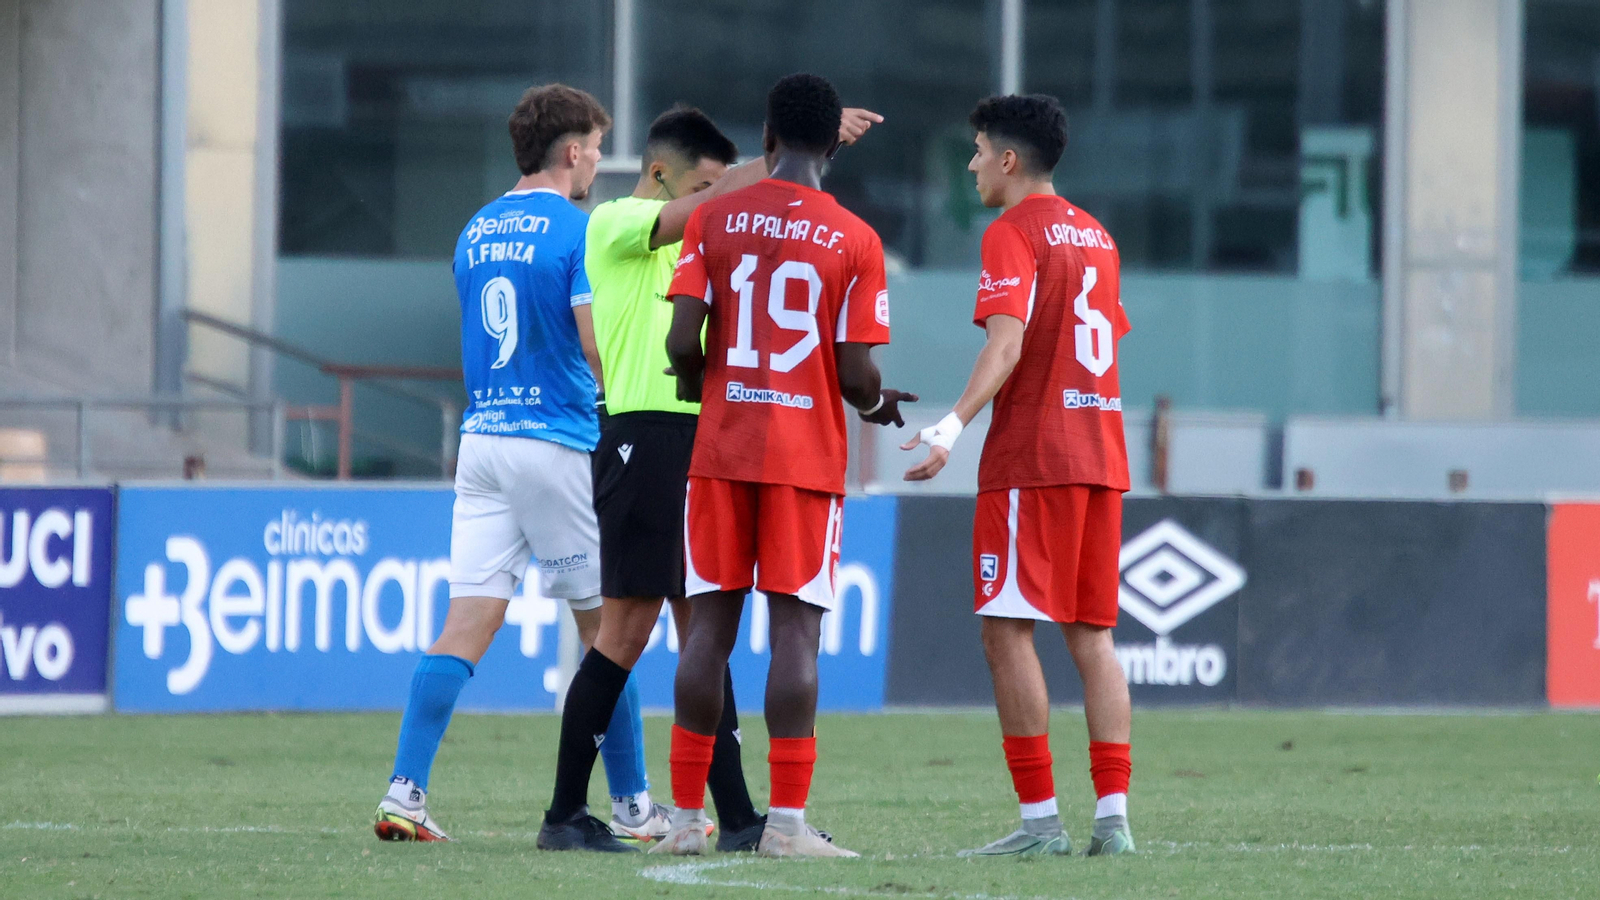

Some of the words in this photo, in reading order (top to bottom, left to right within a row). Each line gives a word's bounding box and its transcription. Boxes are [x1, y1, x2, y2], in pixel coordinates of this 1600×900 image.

[725, 212, 748, 234] LA
[752, 213, 811, 241] PALMA
[812, 225, 845, 255] C.F.
[480, 276, 518, 369] 9
[726, 253, 823, 373] 19
[1074, 267, 1113, 377] 6
[482, 410, 505, 423] High
[742, 389, 813, 409] UNIKALAB
